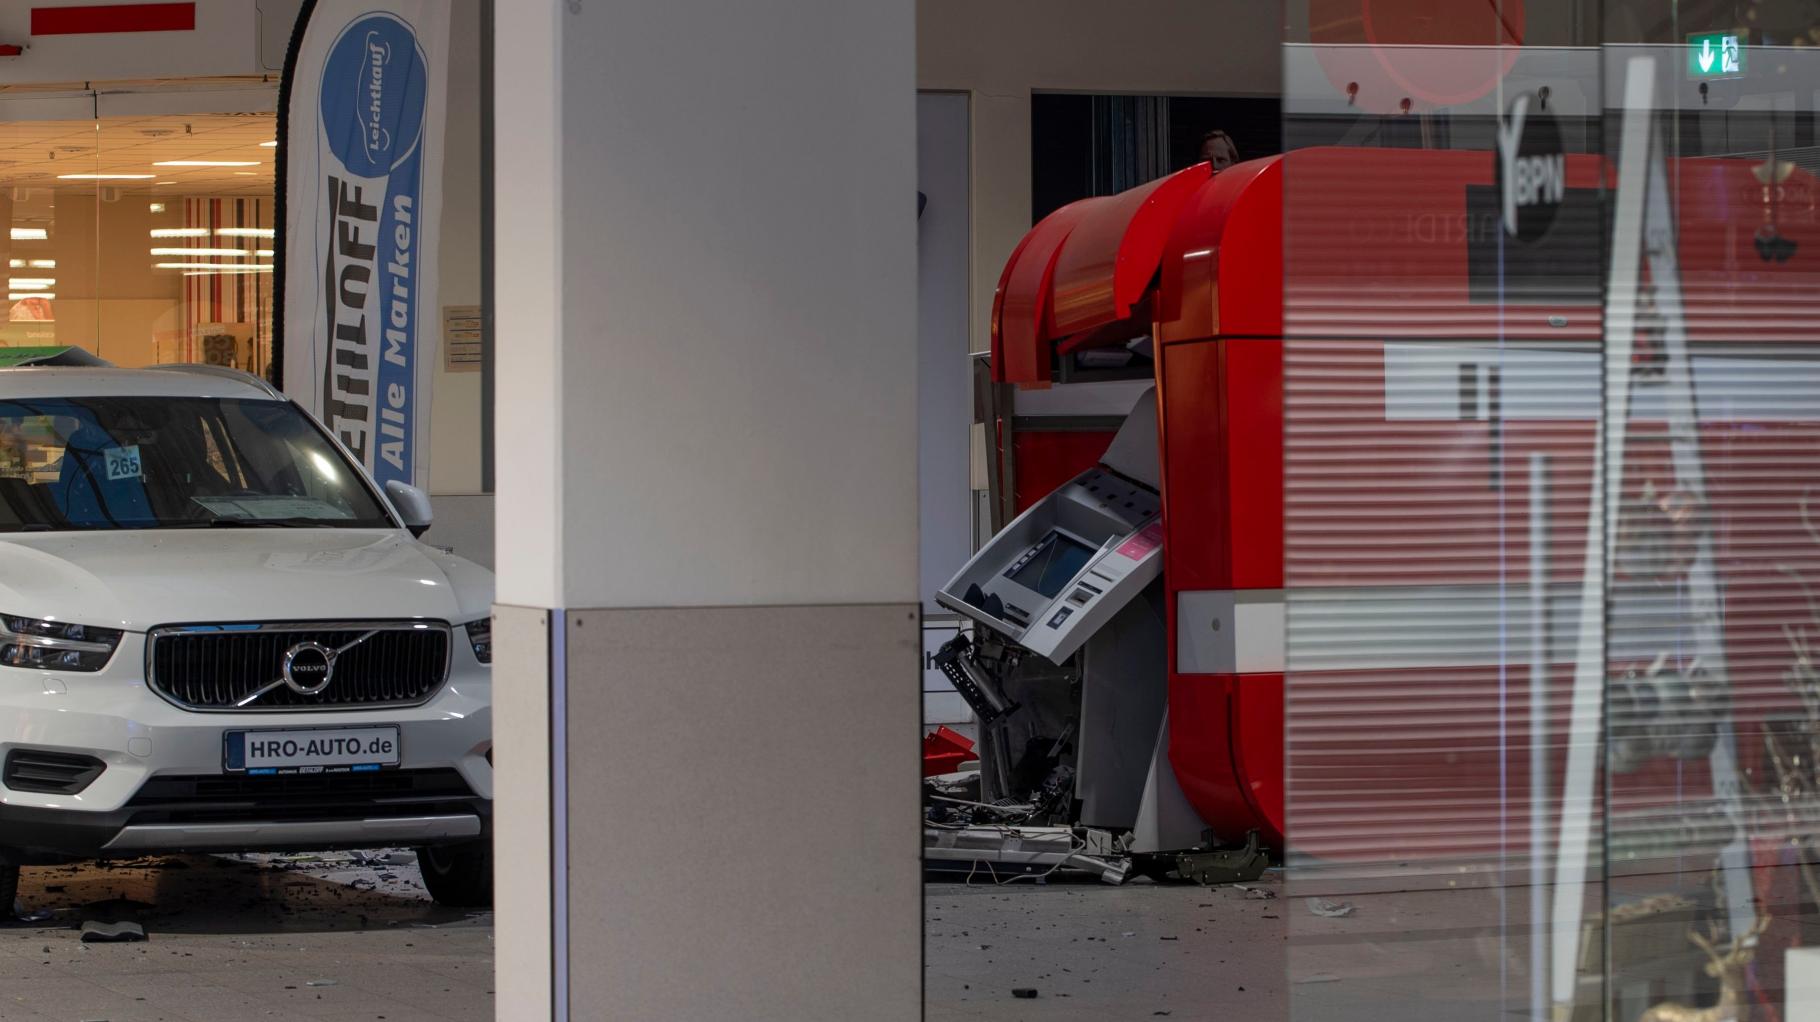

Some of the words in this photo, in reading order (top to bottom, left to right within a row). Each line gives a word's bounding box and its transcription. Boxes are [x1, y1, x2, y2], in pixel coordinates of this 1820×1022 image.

[369, 41, 385, 151] Leichtkauf
[385, 195, 412, 367] Marken
[381, 382, 406, 472] Alle
[110, 457, 139, 477] 265
[292, 664, 327, 672] VOLVO
[250, 737, 393, 758] HRO-AUTO.de
